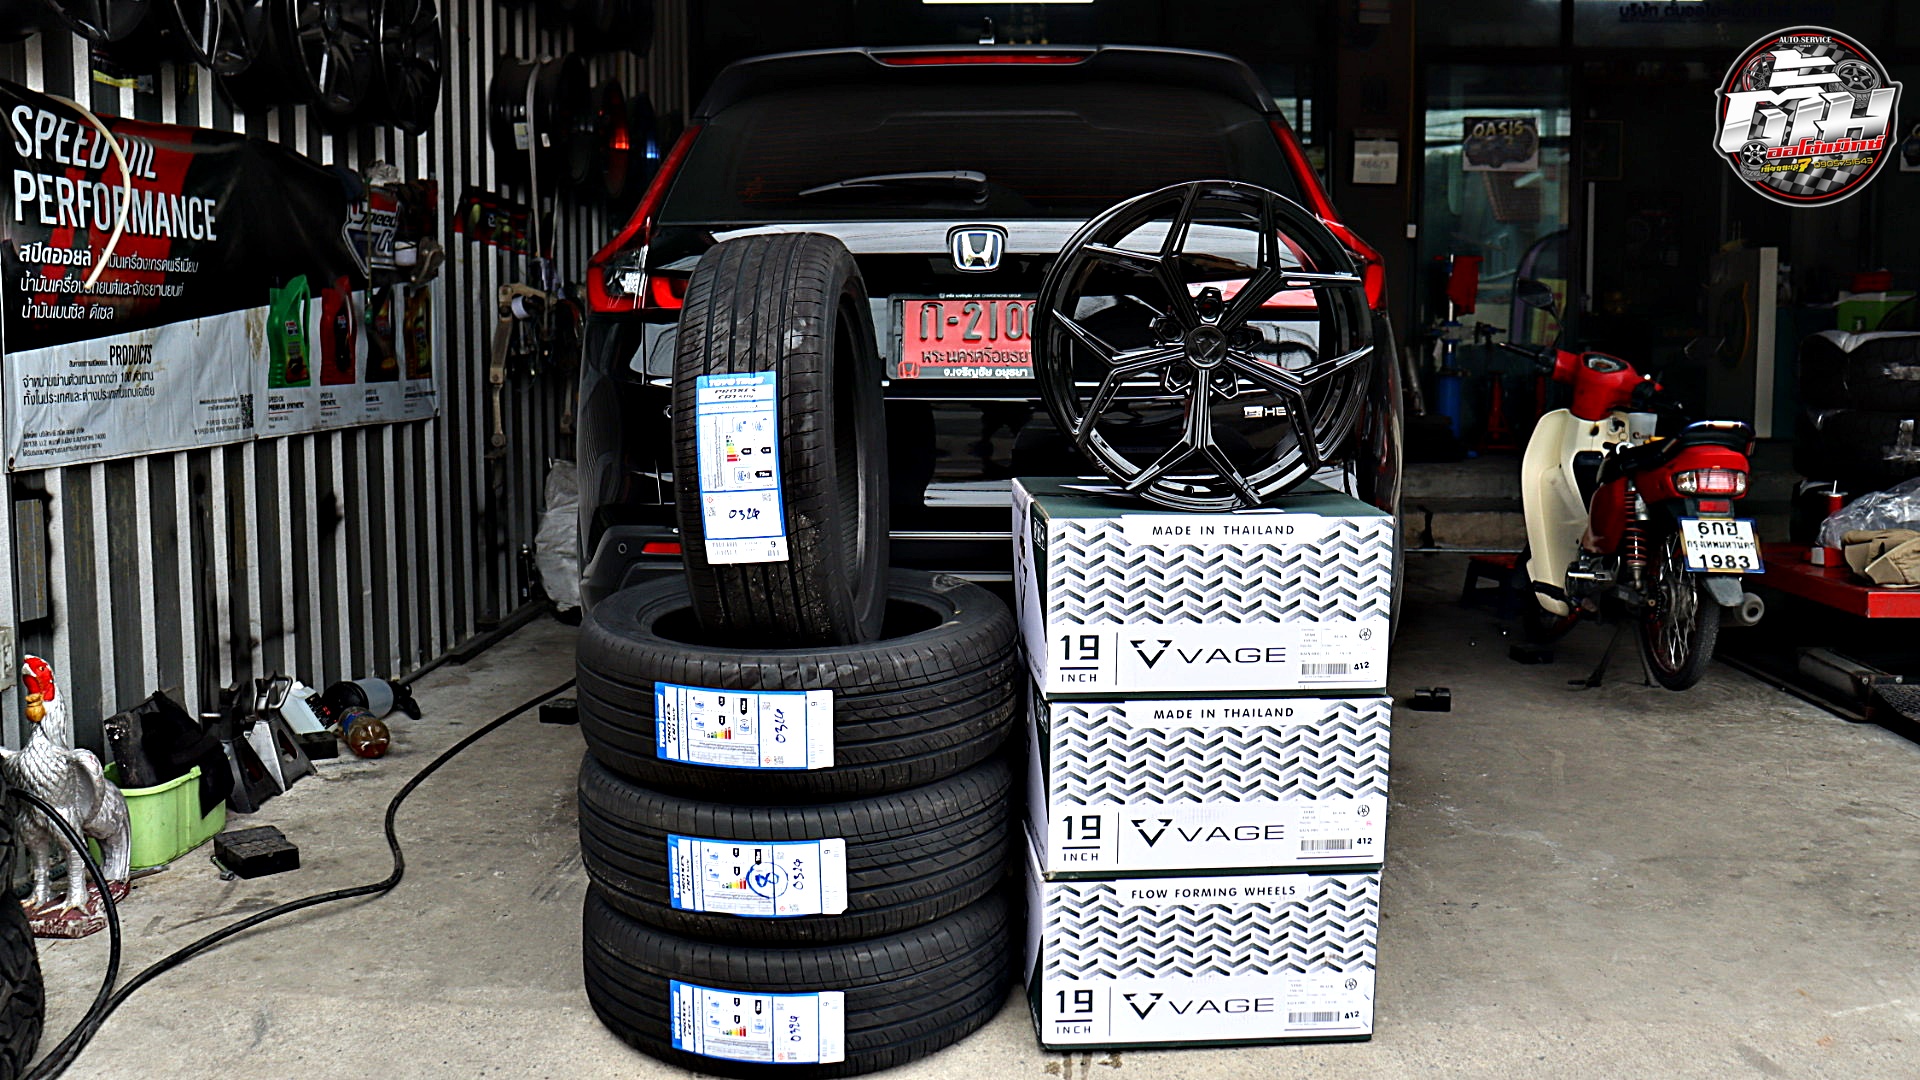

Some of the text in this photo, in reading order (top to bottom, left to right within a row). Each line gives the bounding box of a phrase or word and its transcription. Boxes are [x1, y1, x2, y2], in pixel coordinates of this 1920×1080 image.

[12, 105, 110, 169] SPEED
[1472, 121, 1524, 138] OASIS
[14, 169, 217, 240] PERFORMANCE
[19, 242, 92, 267] สปีดออยล์
[109, 344, 153, 366] PRODUCTS
[1152, 525, 1295, 536] MADE IN THAILAND
[1686, 540, 1756, 551] กรุงเทพมหานคร
[1698, 554, 1751, 569] 1983
[1059, 634, 1286, 664] 19 VAGE
[1353, 661, 1370, 670] 412
[1061, 673, 1097, 683] INCH
[1154, 707, 1294, 719] MADE IN THAILAND
[1062, 814, 1285, 842] 19 VAGE
[1356, 837, 1373, 845] 412
[1063, 852, 1099, 862] INCH
[1131, 885, 1296, 900] FLOW FORMING WHEELS
[1055, 989, 1275, 1015] 19 VAGE
[1344, 1010, 1360, 1019] 412
[1056, 1025, 1092, 1035] INCH
